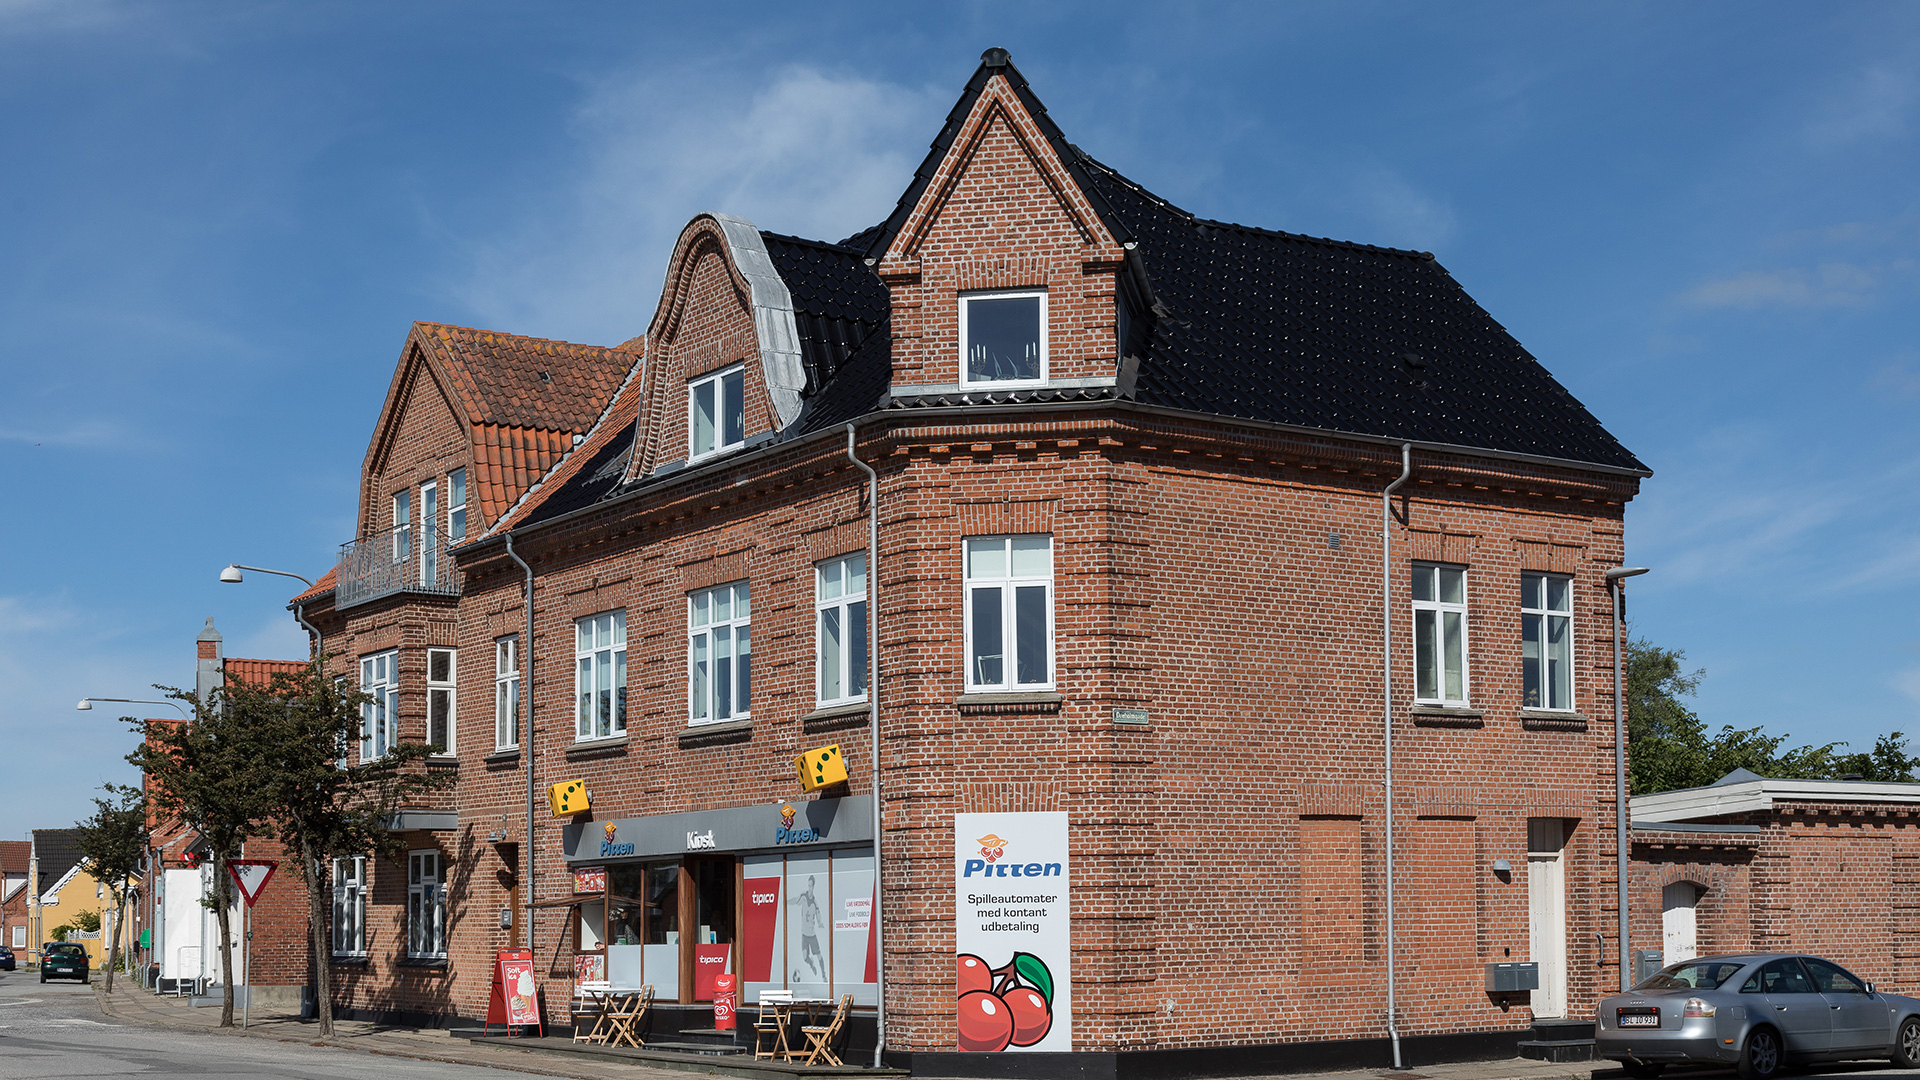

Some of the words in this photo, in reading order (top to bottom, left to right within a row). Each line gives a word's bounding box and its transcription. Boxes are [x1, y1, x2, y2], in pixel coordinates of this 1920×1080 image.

[686, 830, 716, 850] Kiosk
[776, 827, 820, 844] Pitten
[600, 841, 635, 856] Pitten
[963, 859, 1062, 878] Pitten
[752, 891, 775, 906] tipico
[967, 893, 1058, 906] Spilleautomater
[977, 908, 1001, 918] med
[1003, 908, 1048, 918] kontant
[981, 921, 1040, 934] udbetaling
[699, 955, 724, 965] tipico
